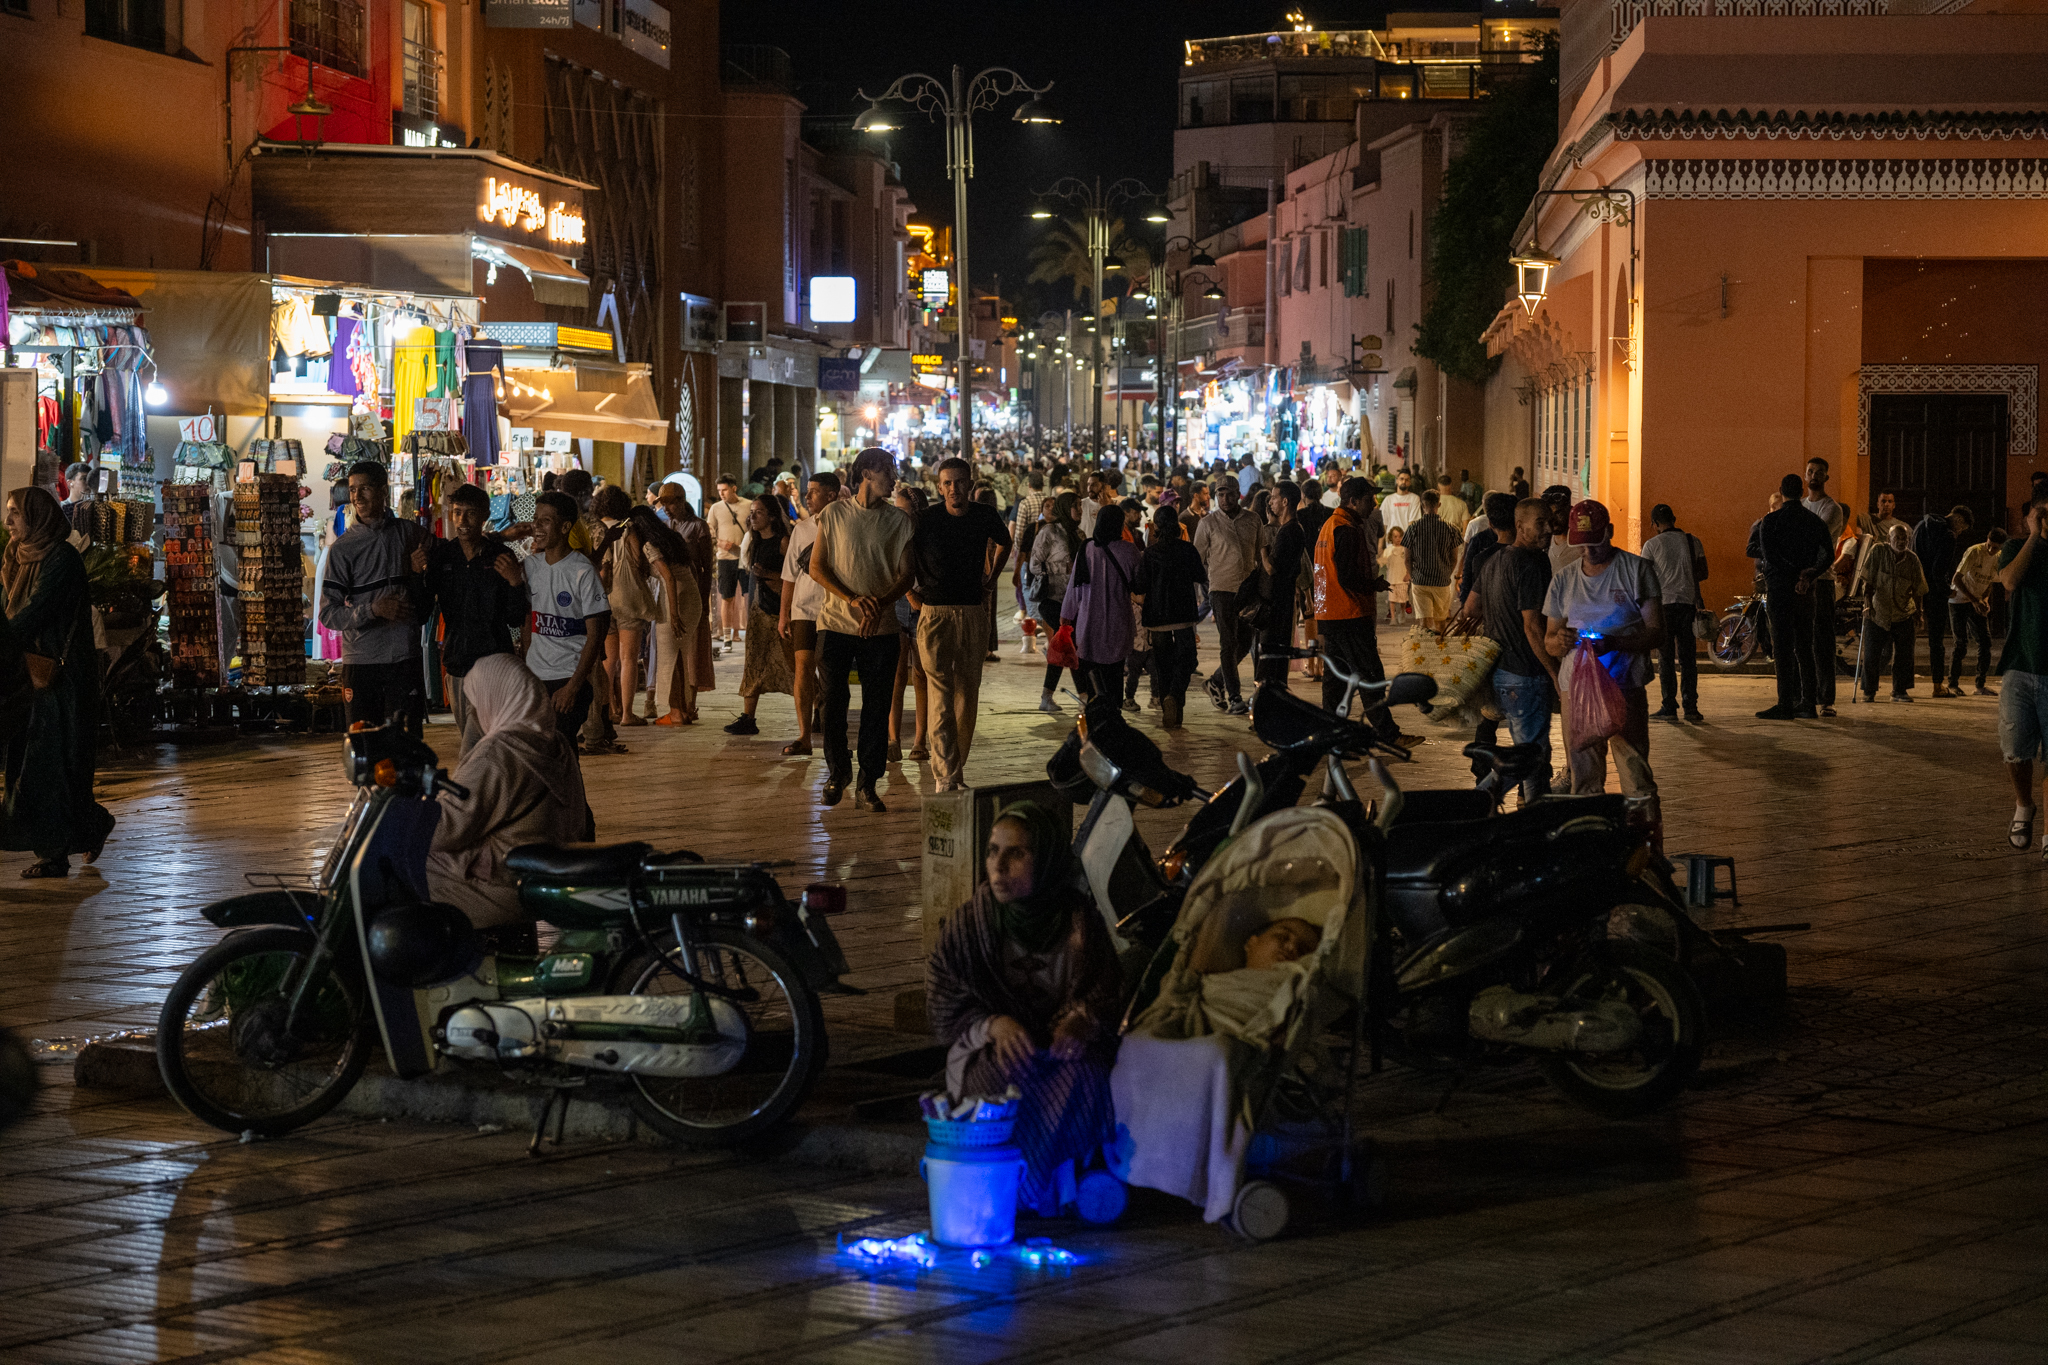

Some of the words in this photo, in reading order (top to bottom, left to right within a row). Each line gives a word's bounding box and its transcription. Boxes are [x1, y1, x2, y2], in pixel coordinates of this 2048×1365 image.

[540, 16, 569, 26] 24h/7j
[912, 355, 943, 365] SNACK
[423, 398, 442, 429] 5
[184, 416, 214, 442] 10
[512, 434, 519, 442] 5
[550, 437, 558, 446] 5
[500, 452, 510, 465] 5
[241, 463, 252, 482] 10
[539, 626, 570, 636] IRWAYS
[650, 888, 709, 905] YAMAHA
